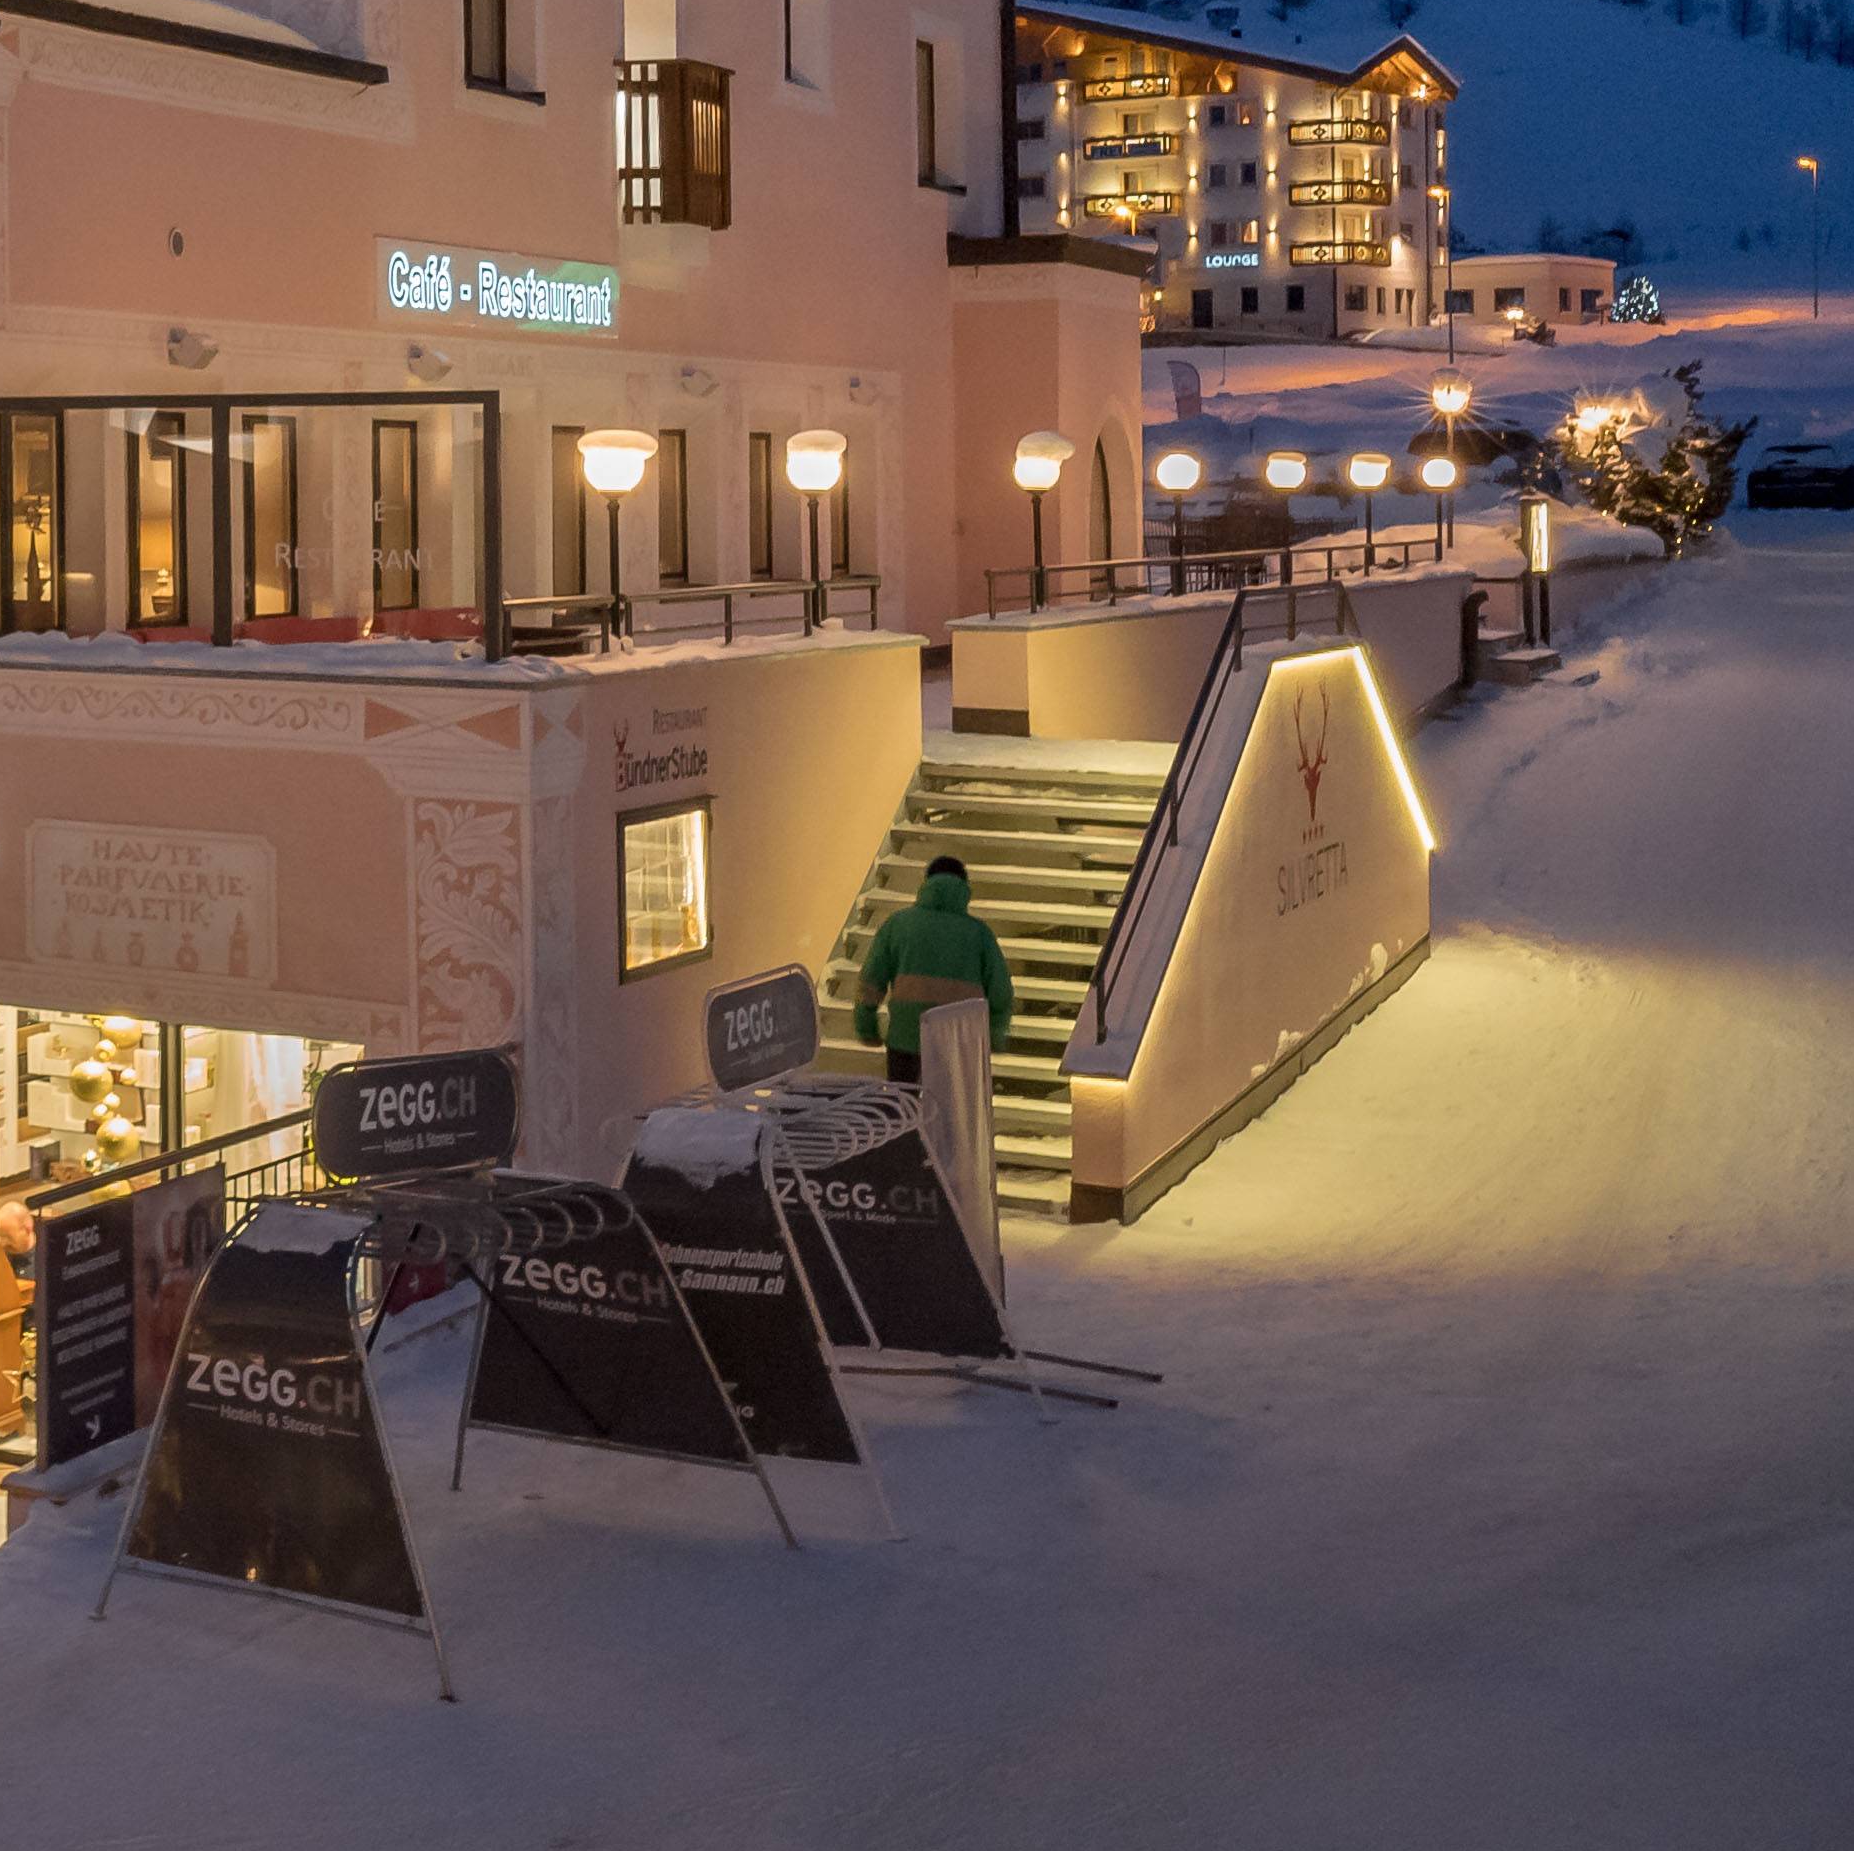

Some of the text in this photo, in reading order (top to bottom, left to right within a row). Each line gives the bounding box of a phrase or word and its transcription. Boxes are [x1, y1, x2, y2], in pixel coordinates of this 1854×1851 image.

[388, 250, 452, 312] Café
[478, 260, 612, 326] Restaurant
[679, 1269, 786, 1296] Samnaun.ch
[219, 1403, 327, 1437] Hotels & Stores
